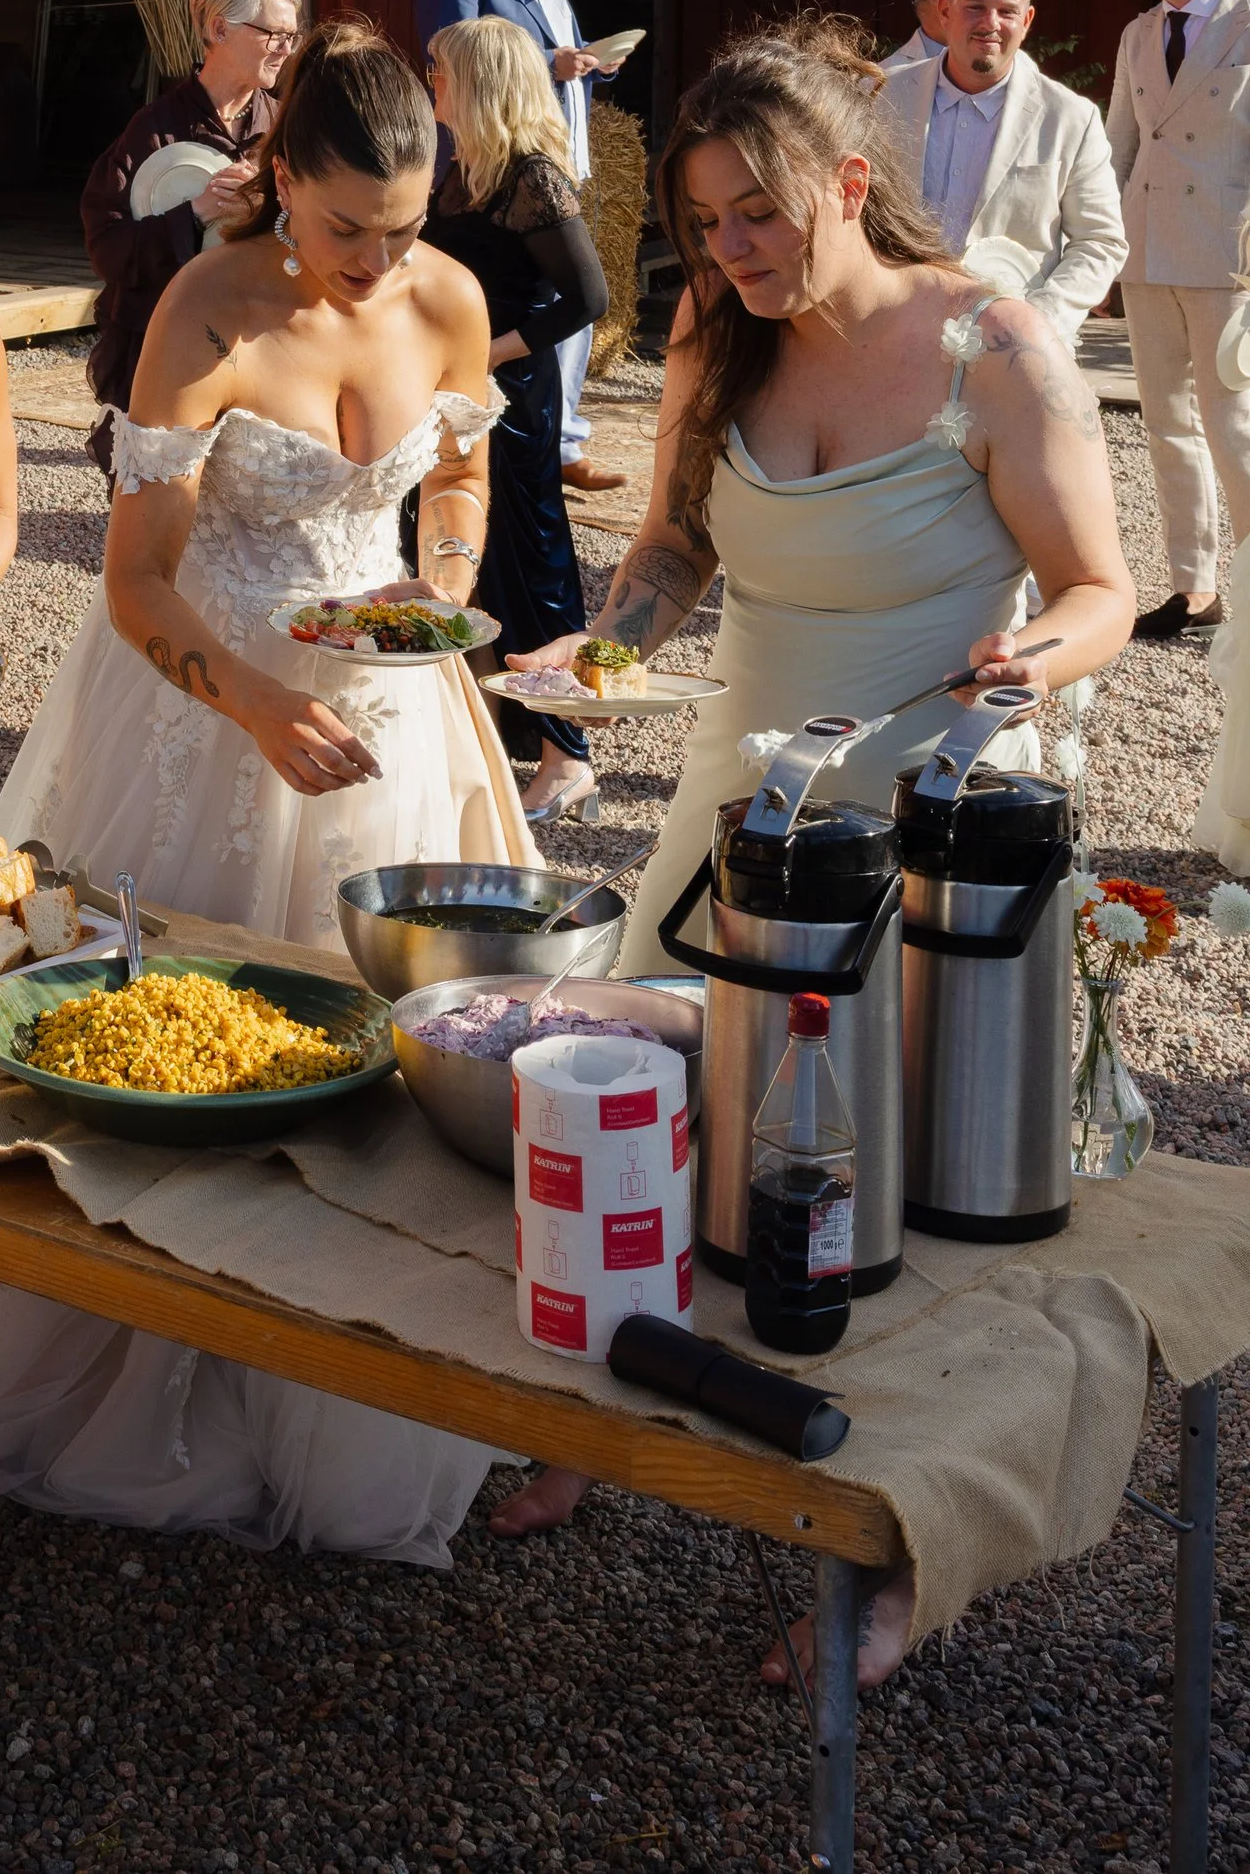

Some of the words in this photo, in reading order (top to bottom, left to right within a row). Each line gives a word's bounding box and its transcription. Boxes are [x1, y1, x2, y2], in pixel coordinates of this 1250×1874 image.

[534, 1155, 572, 1173] KATRIN
[610, 1219, 654, 1233] KATRIN
[820, 1239, 833, 1251] 1000
[537, 1294, 574, 1313] KATRIN
